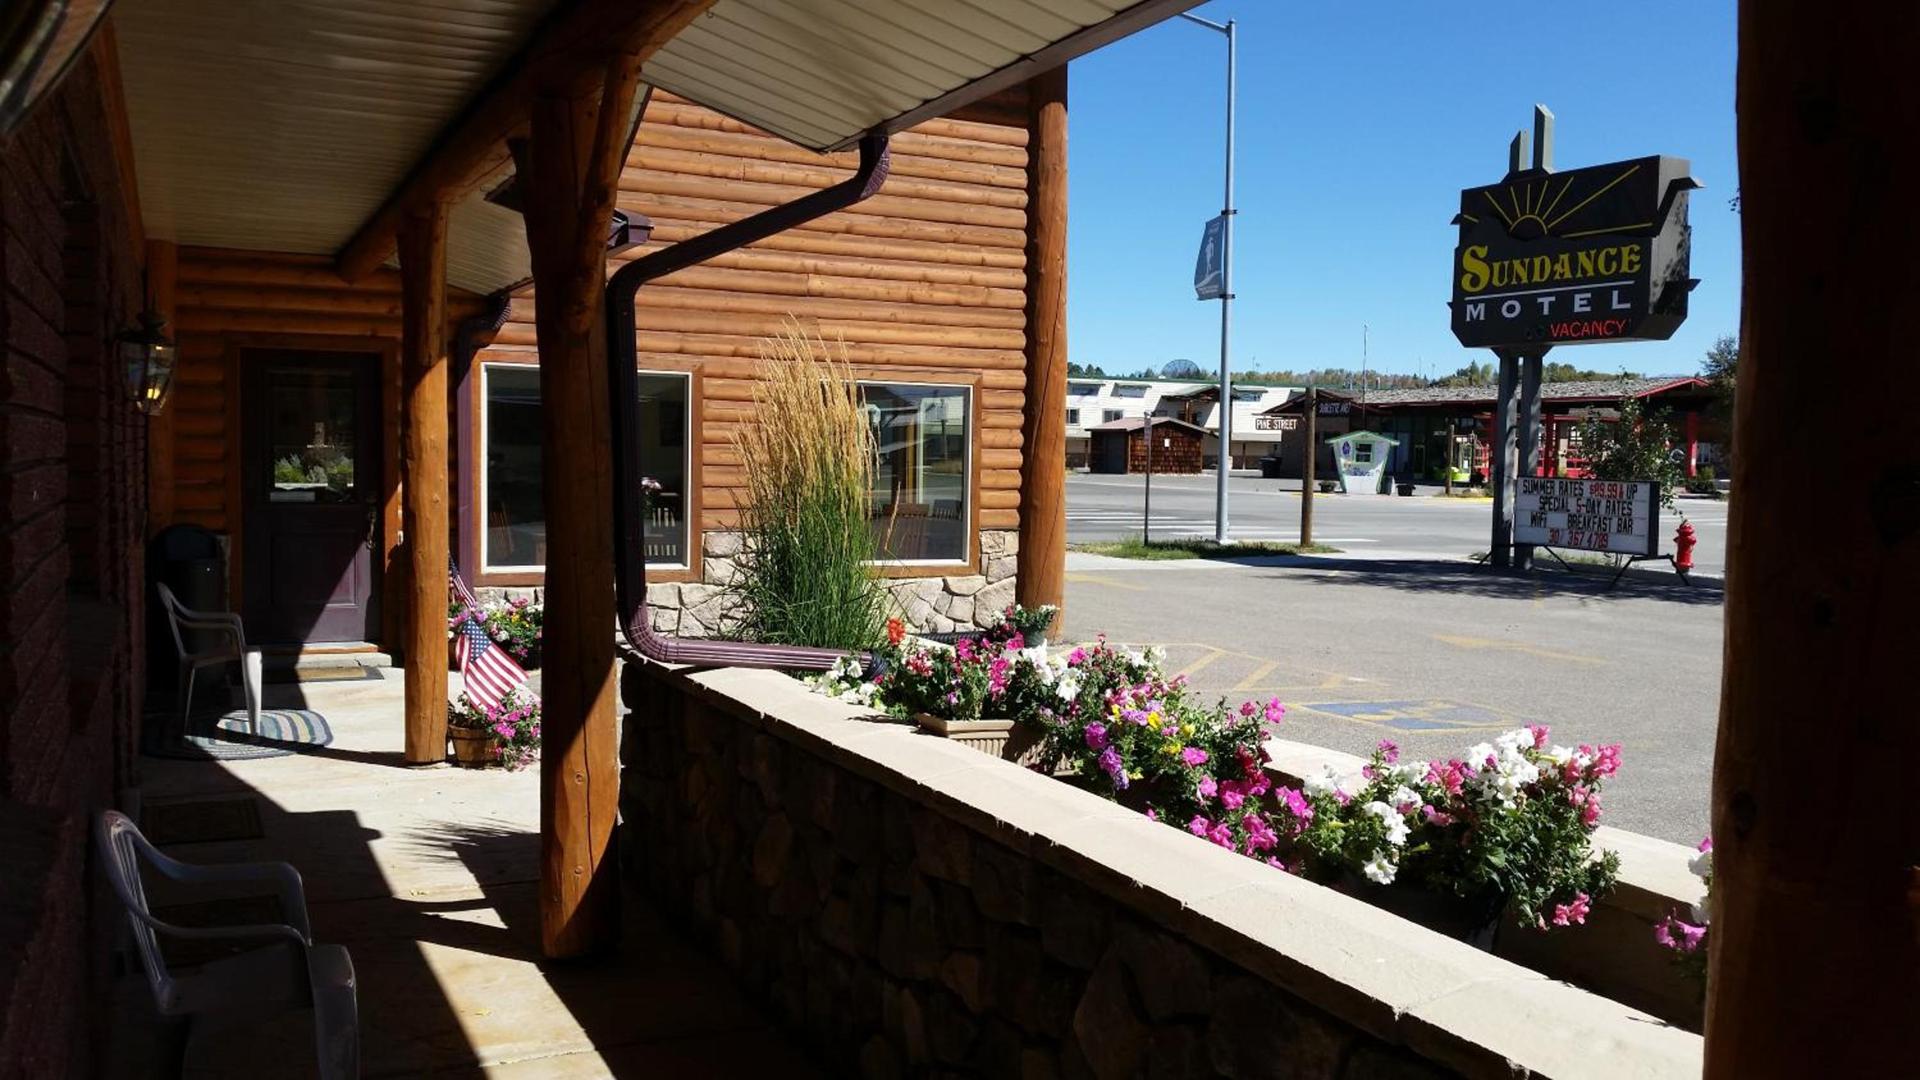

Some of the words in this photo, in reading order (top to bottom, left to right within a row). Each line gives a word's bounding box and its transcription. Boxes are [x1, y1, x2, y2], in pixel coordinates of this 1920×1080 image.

[1461, 244, 1641, 293] SUNDANCE
[1465, 290, 1632, 322] MOTEL
[1550, 319, 1628, 338] VACANCY
[1256, 419, 1271, 430] PINE
[1273, 419, 1298, 430] STREET
[1523, 480, 1556, 496] SUMMER
[1560, 481, 1584, 497] RATES
[1626, 484, 1638, 500] UP
[1539, 496, 1571, 513] SPECIAL
[1605, 500, 1633, 517] RATES
[1567, 513, 1613, 533] BREAKFAST
[1617, 517, 1634, 535] BAR
